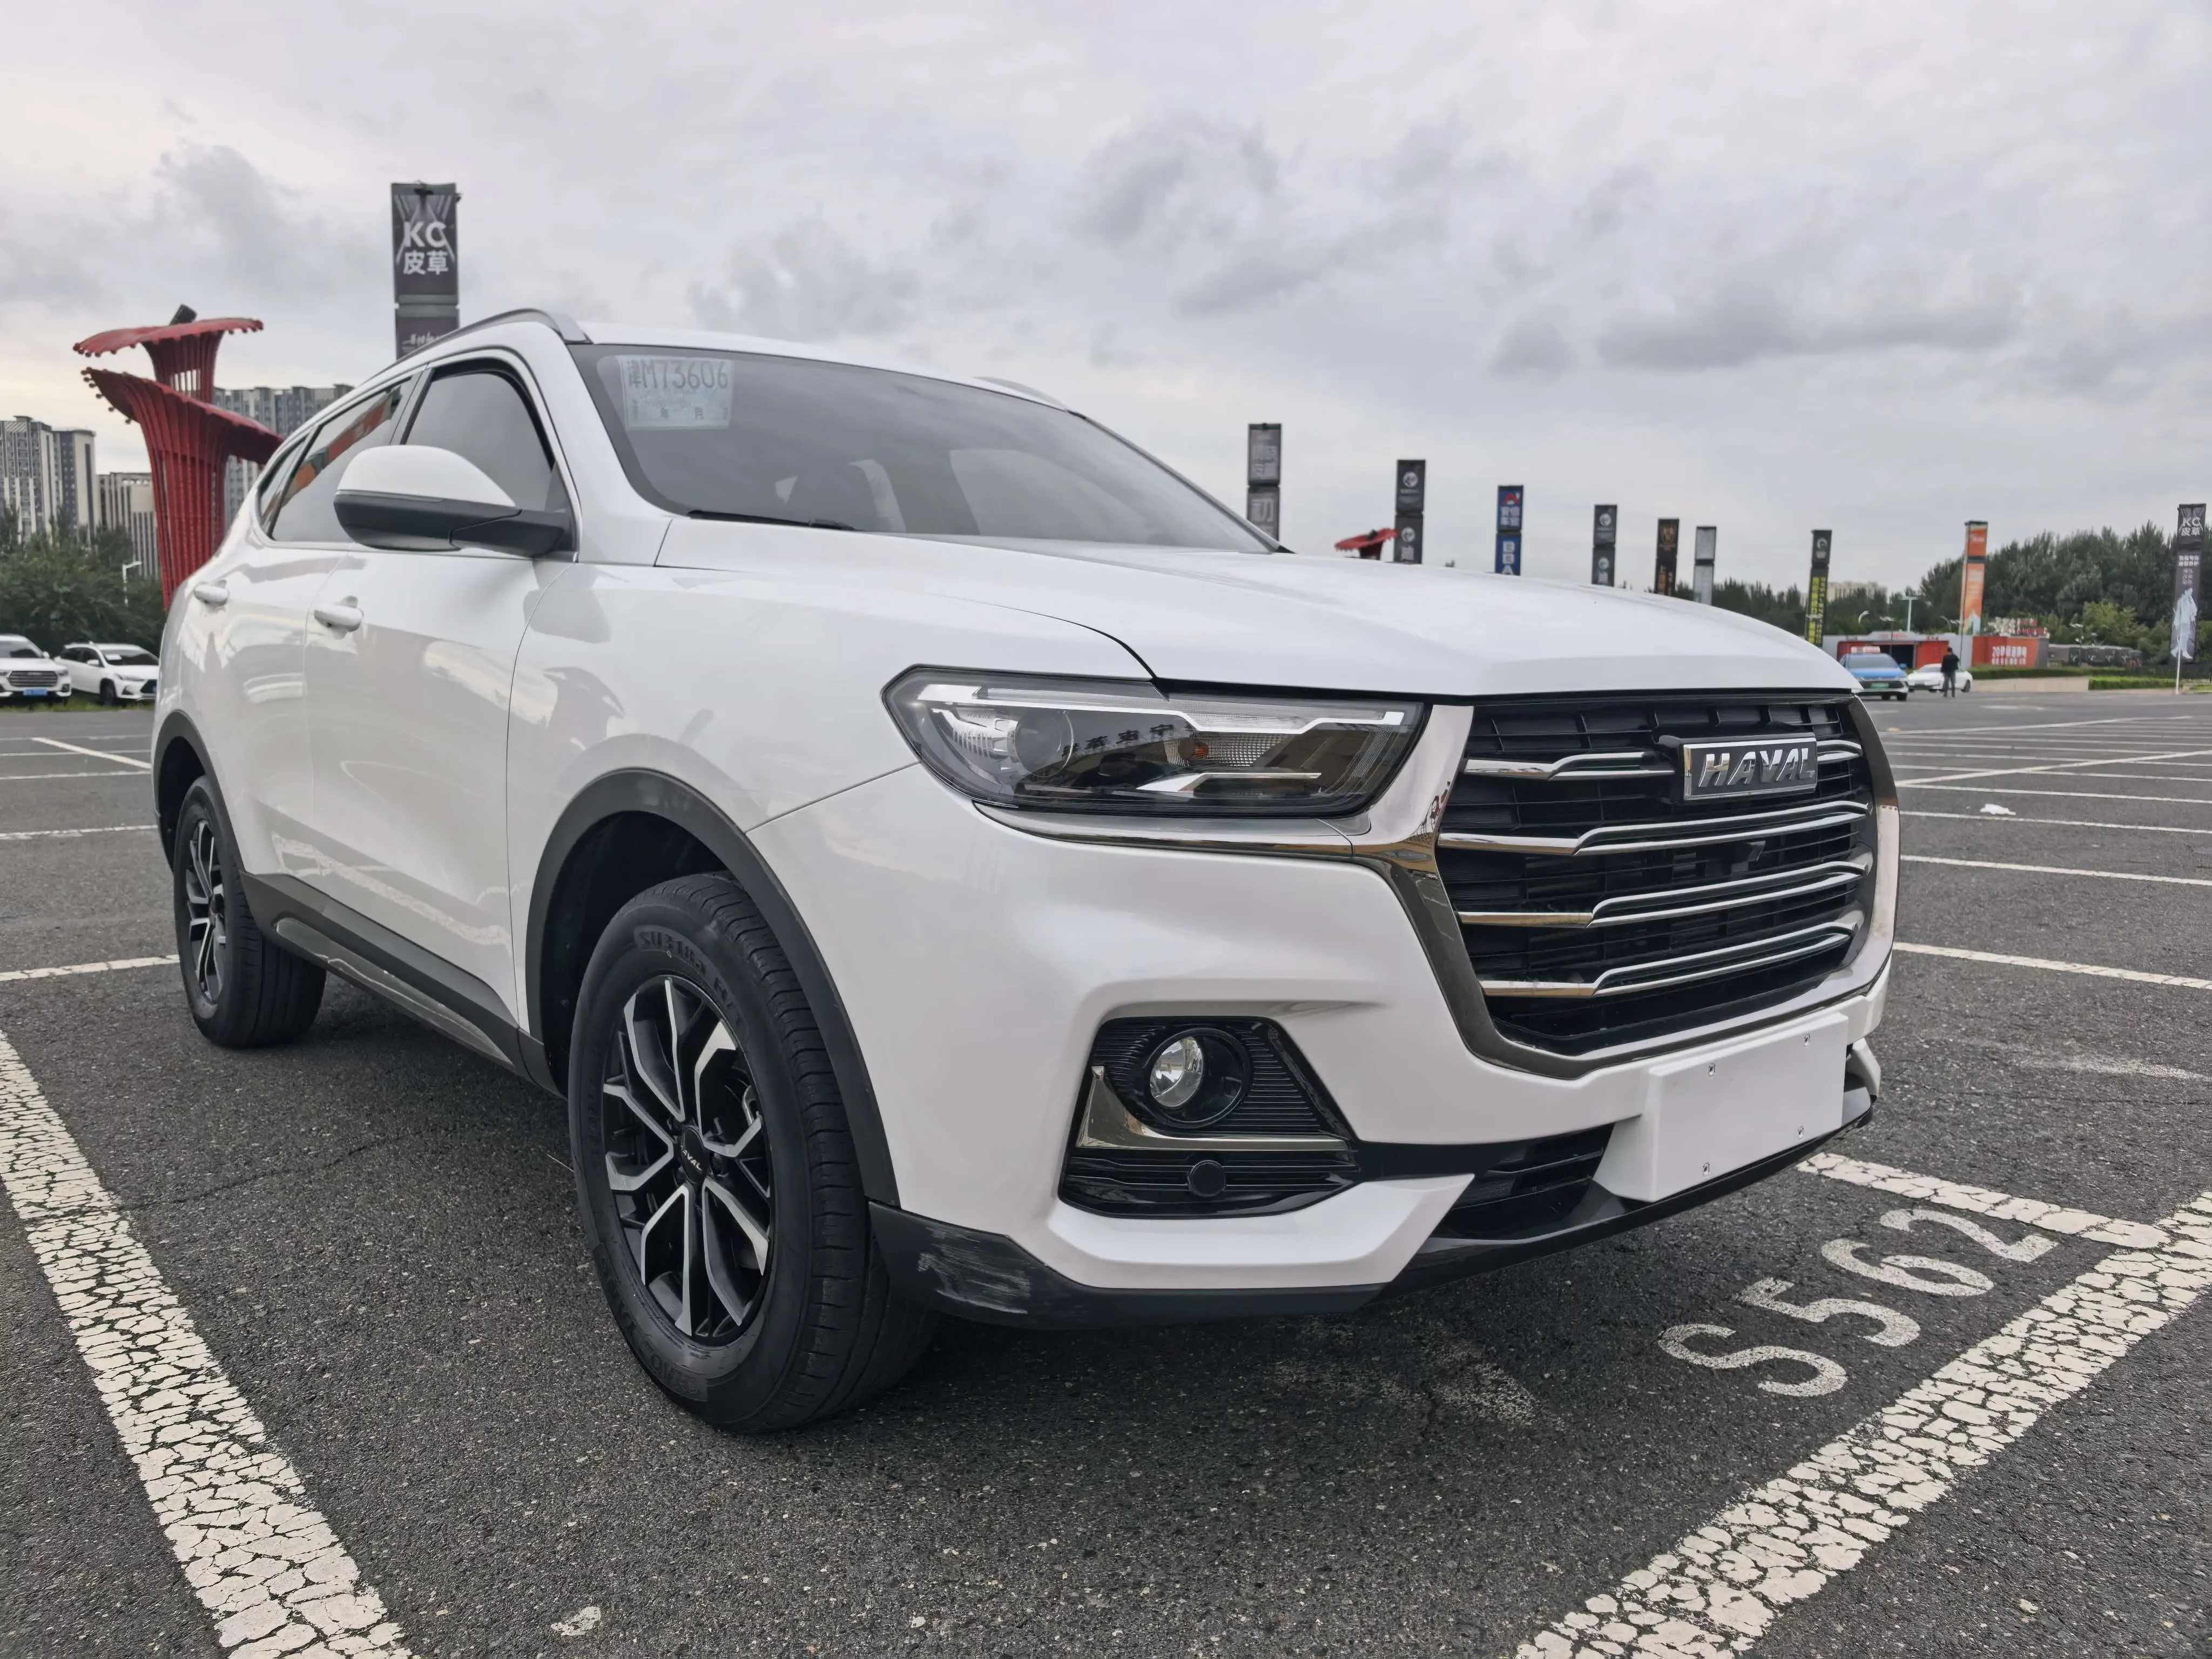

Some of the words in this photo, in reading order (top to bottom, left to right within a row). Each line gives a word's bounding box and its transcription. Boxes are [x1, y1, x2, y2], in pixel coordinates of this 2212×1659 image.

[404, 221, 447, 248] KC
[403, 250, 449, 275] 皮草
[1698, 748, 1816, 787] HAVAL
[1656, 1206, 2059, 1398] S562
